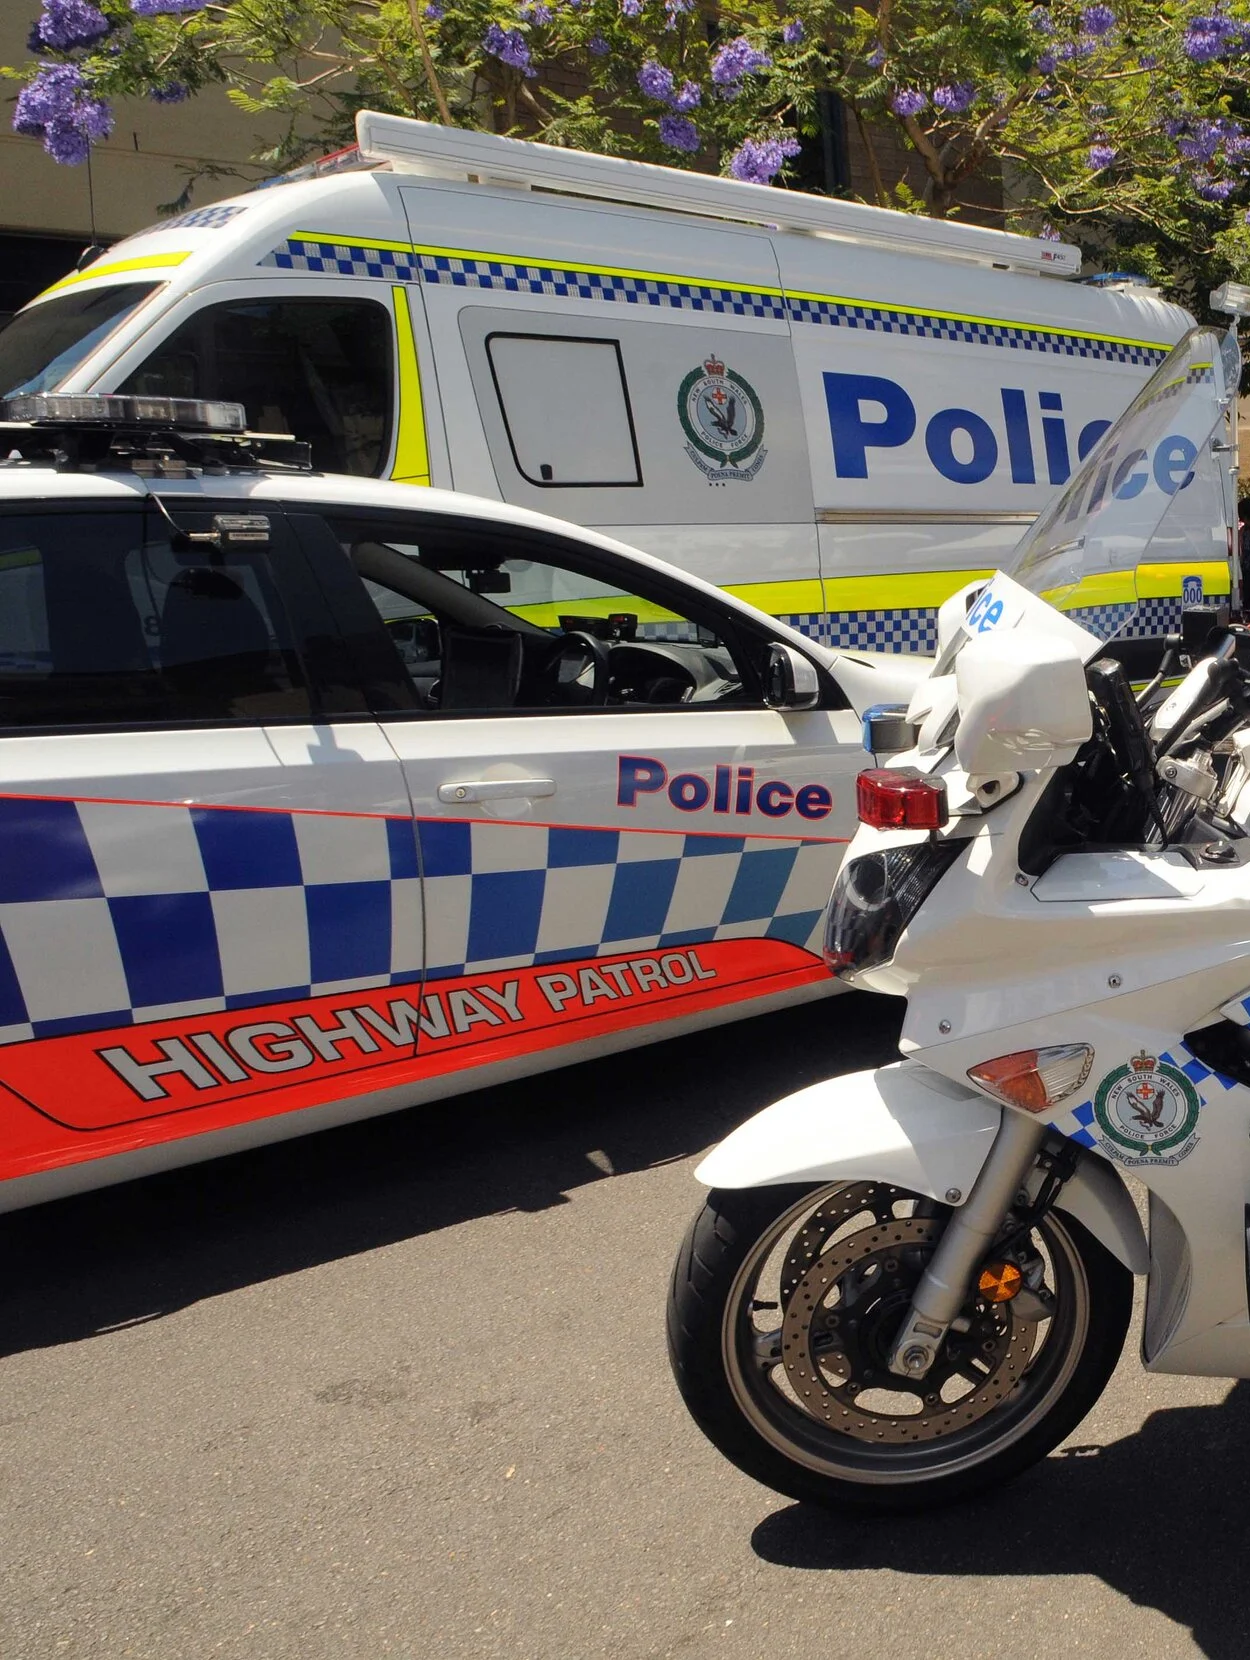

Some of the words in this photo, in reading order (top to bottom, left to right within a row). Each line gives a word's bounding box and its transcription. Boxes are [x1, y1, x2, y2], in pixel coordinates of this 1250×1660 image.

[822, 371, 1197, 500] Police
[1183, 588, 1202, 604] 000
[616, 755, 833, 821] Police
[94, 979, 525, 1102] HIGHWAY
[536, 948, 718, 1014] PATROL
[1111, 1085, 1124, 1100] NEW
[1127, 1074, 1153, 1083] SOUTH
[1160, 1077, 1181, 1097] WALES
[1119, 1125, 1145, 1140] POLICE
[1154, 1124, 1178, 1139] FORCE
